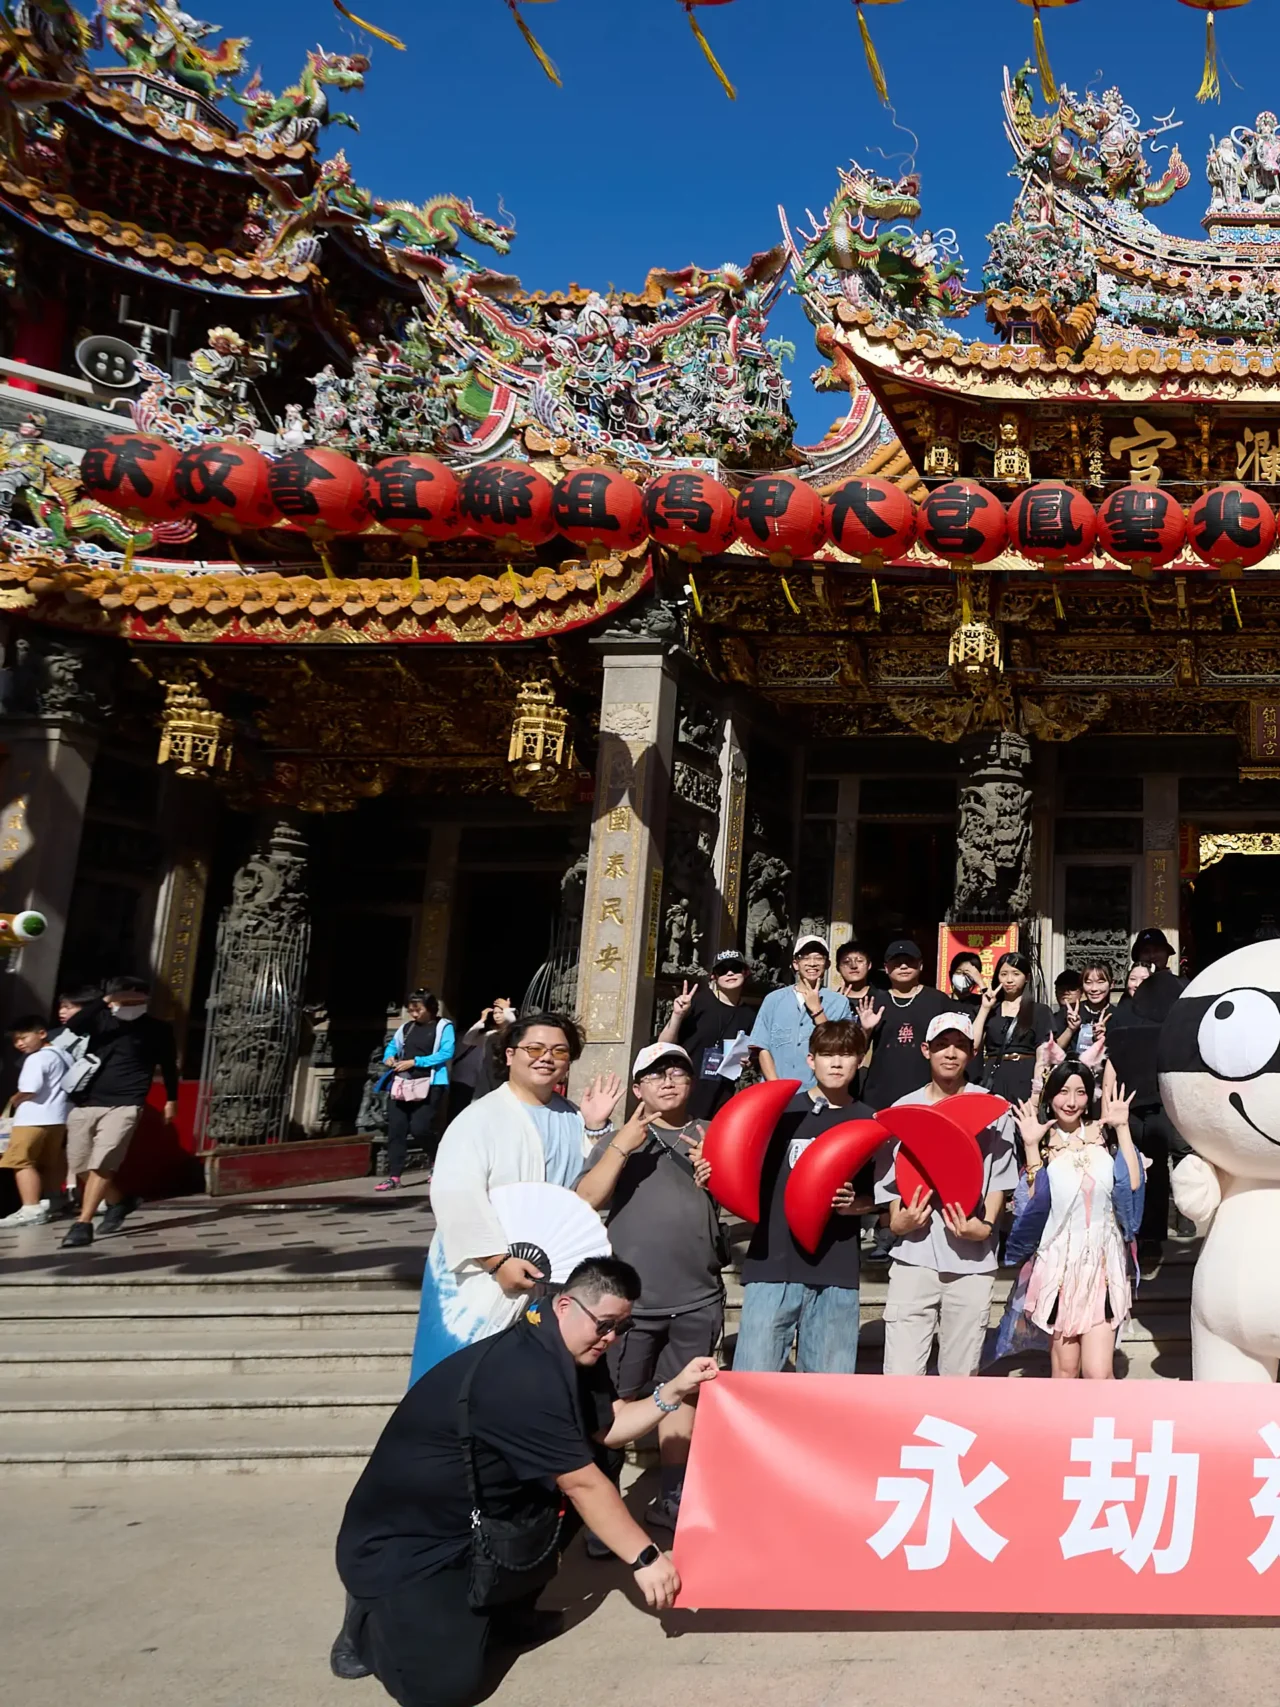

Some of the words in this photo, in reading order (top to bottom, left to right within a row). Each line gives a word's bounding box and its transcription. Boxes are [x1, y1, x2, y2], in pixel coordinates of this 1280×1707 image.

[1262, 706, 1278, 756] 鎮瀾宮
[593, 805, 631, 973] 國泰民安
[967, 933, 1006, 947] 歡迎
[897, 1025, 914, 1043] 樂
